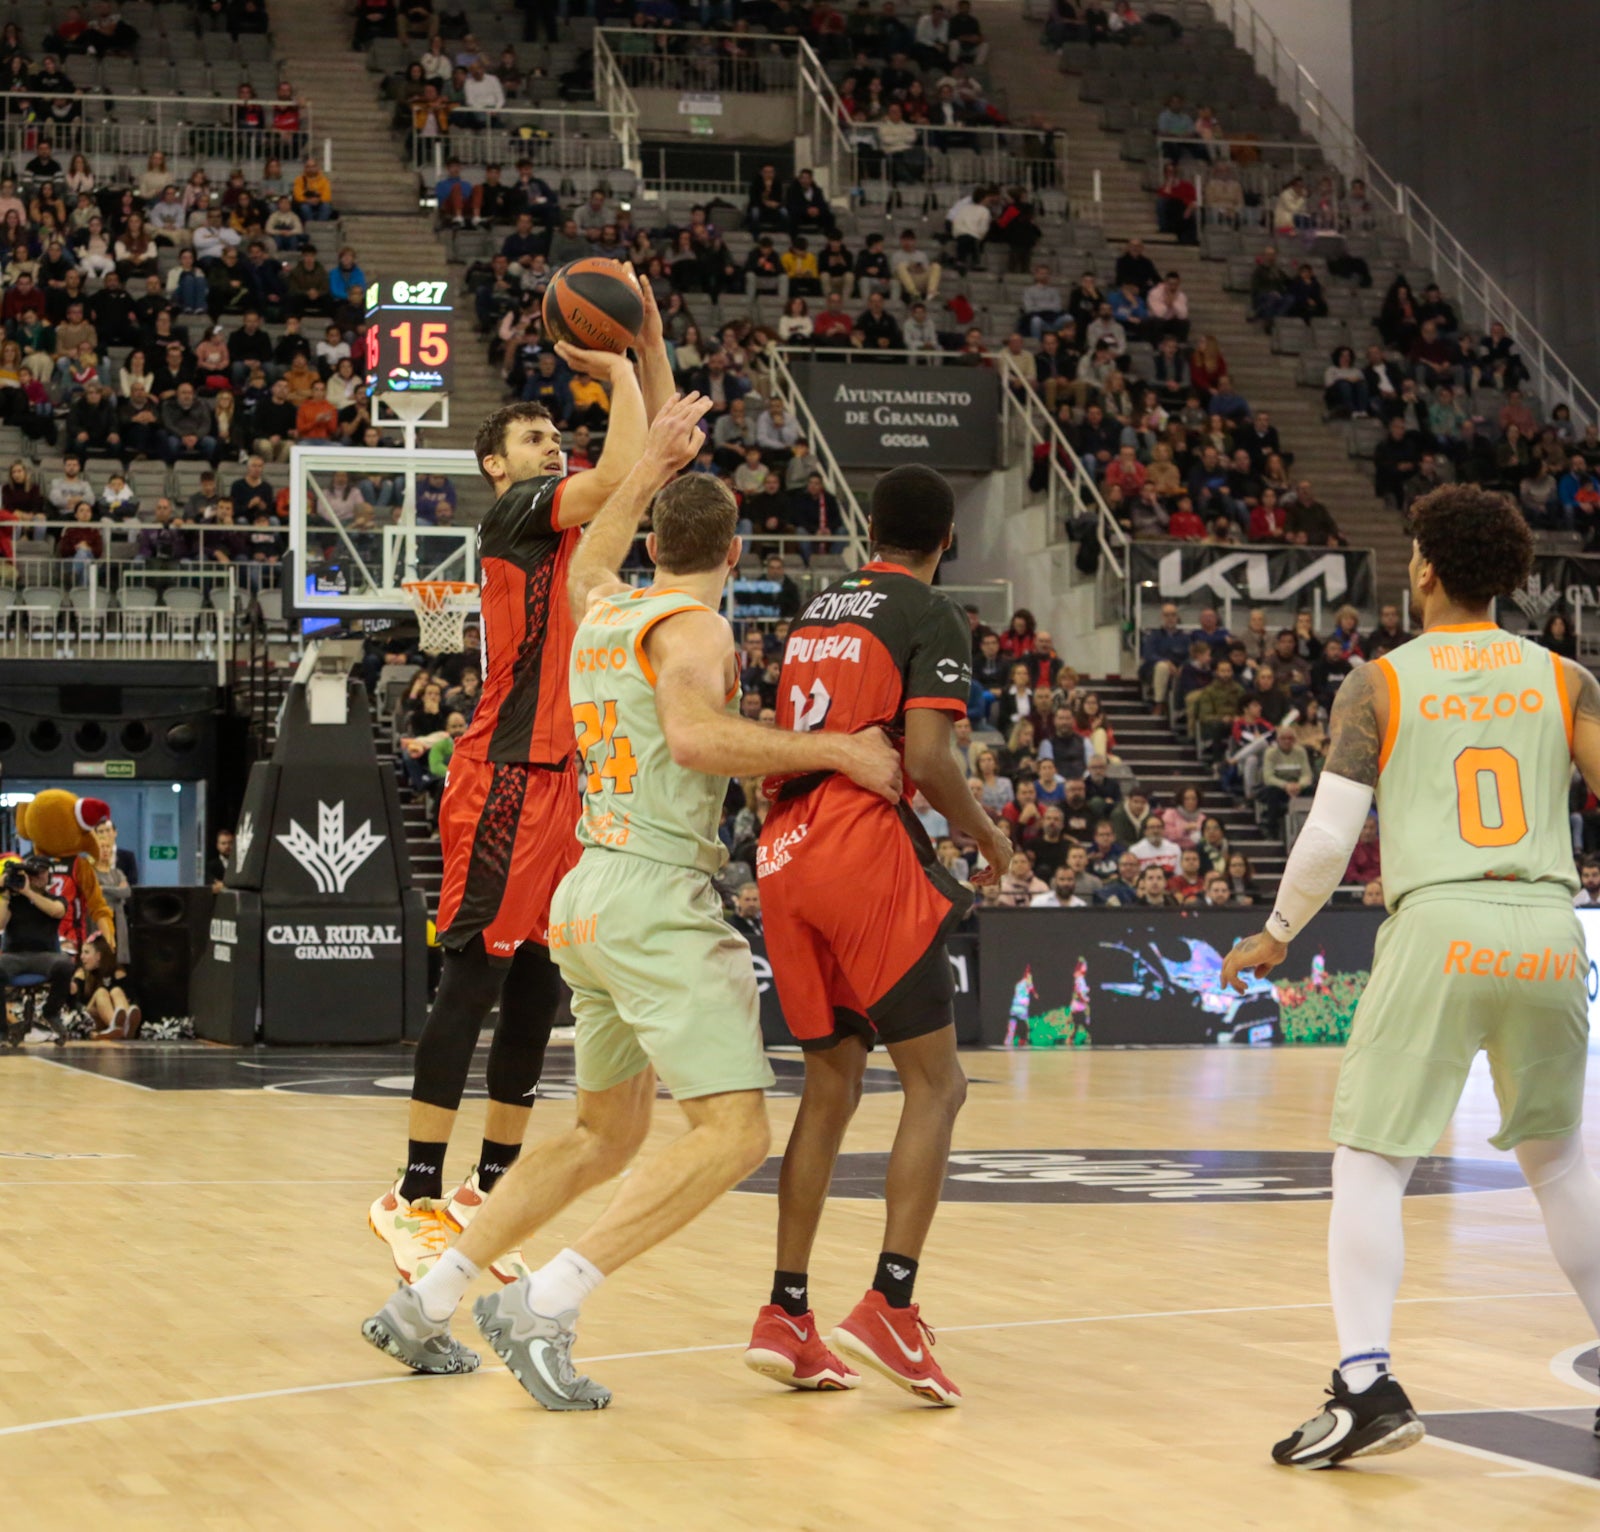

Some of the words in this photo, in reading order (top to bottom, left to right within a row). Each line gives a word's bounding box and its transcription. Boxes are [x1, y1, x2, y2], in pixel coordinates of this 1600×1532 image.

[392, 281, 448, 304] 6:27
[390, 321, 449, 366] 15
[834, 384, 972, 406] AYUNTAMIENTO
[845, 411, 869, 425] DE
[873, 406, 960, 427] GRANADA
[1429, 641, 1522, 672] HOWARD
[1419, 688, 1544, 722] CAZOO
[572, 699, 639, 795] 24
[1454, 746, 1528, 848] 0
[267, 925, 321, 945] CAJA
[325, 925, 402, 944] RURAL
[295, 946, 374, 959] GRANADA
[1443, 940, 1578, 982] Recalvi
[408, 1163, 437, 1174] vive
